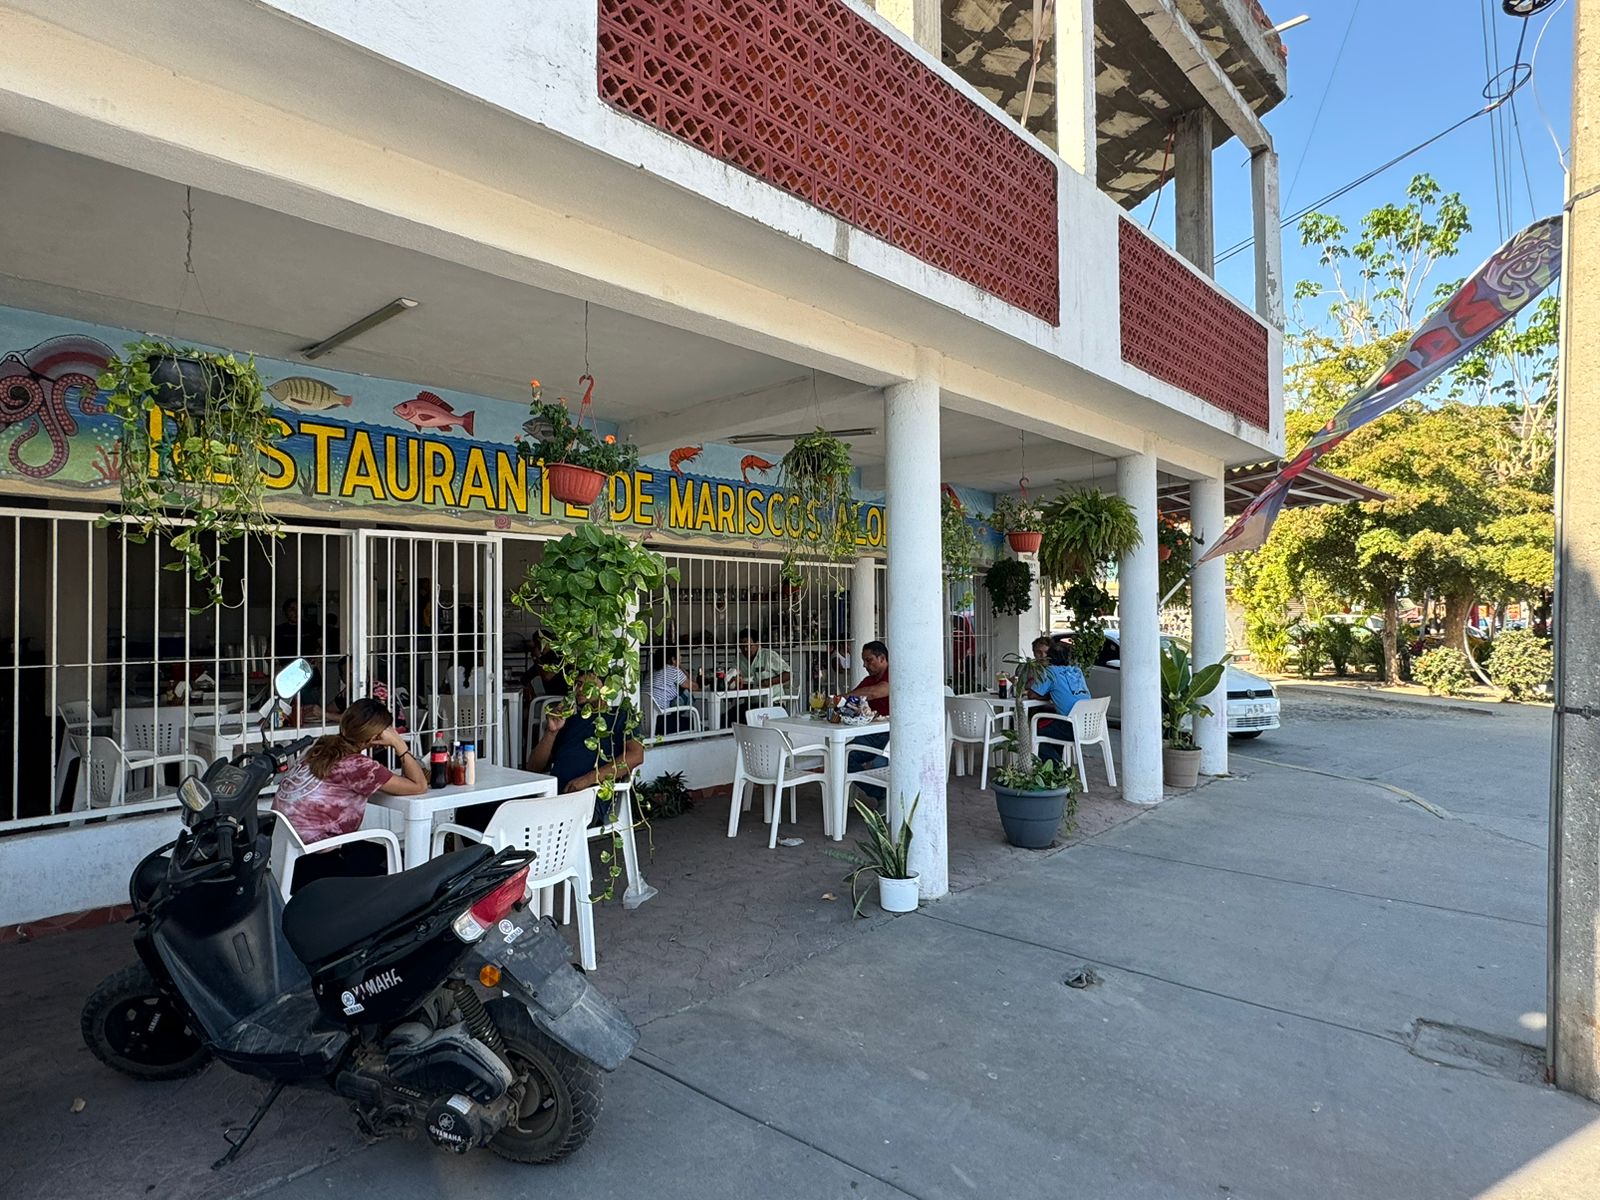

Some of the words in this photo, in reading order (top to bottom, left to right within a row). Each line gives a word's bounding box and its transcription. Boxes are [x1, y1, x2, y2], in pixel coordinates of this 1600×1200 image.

[607, 469, 654, 526] DE
[669, 475, 822, 540] MARISCOS
[435, 1128, 462, 1143] YAMAHA
